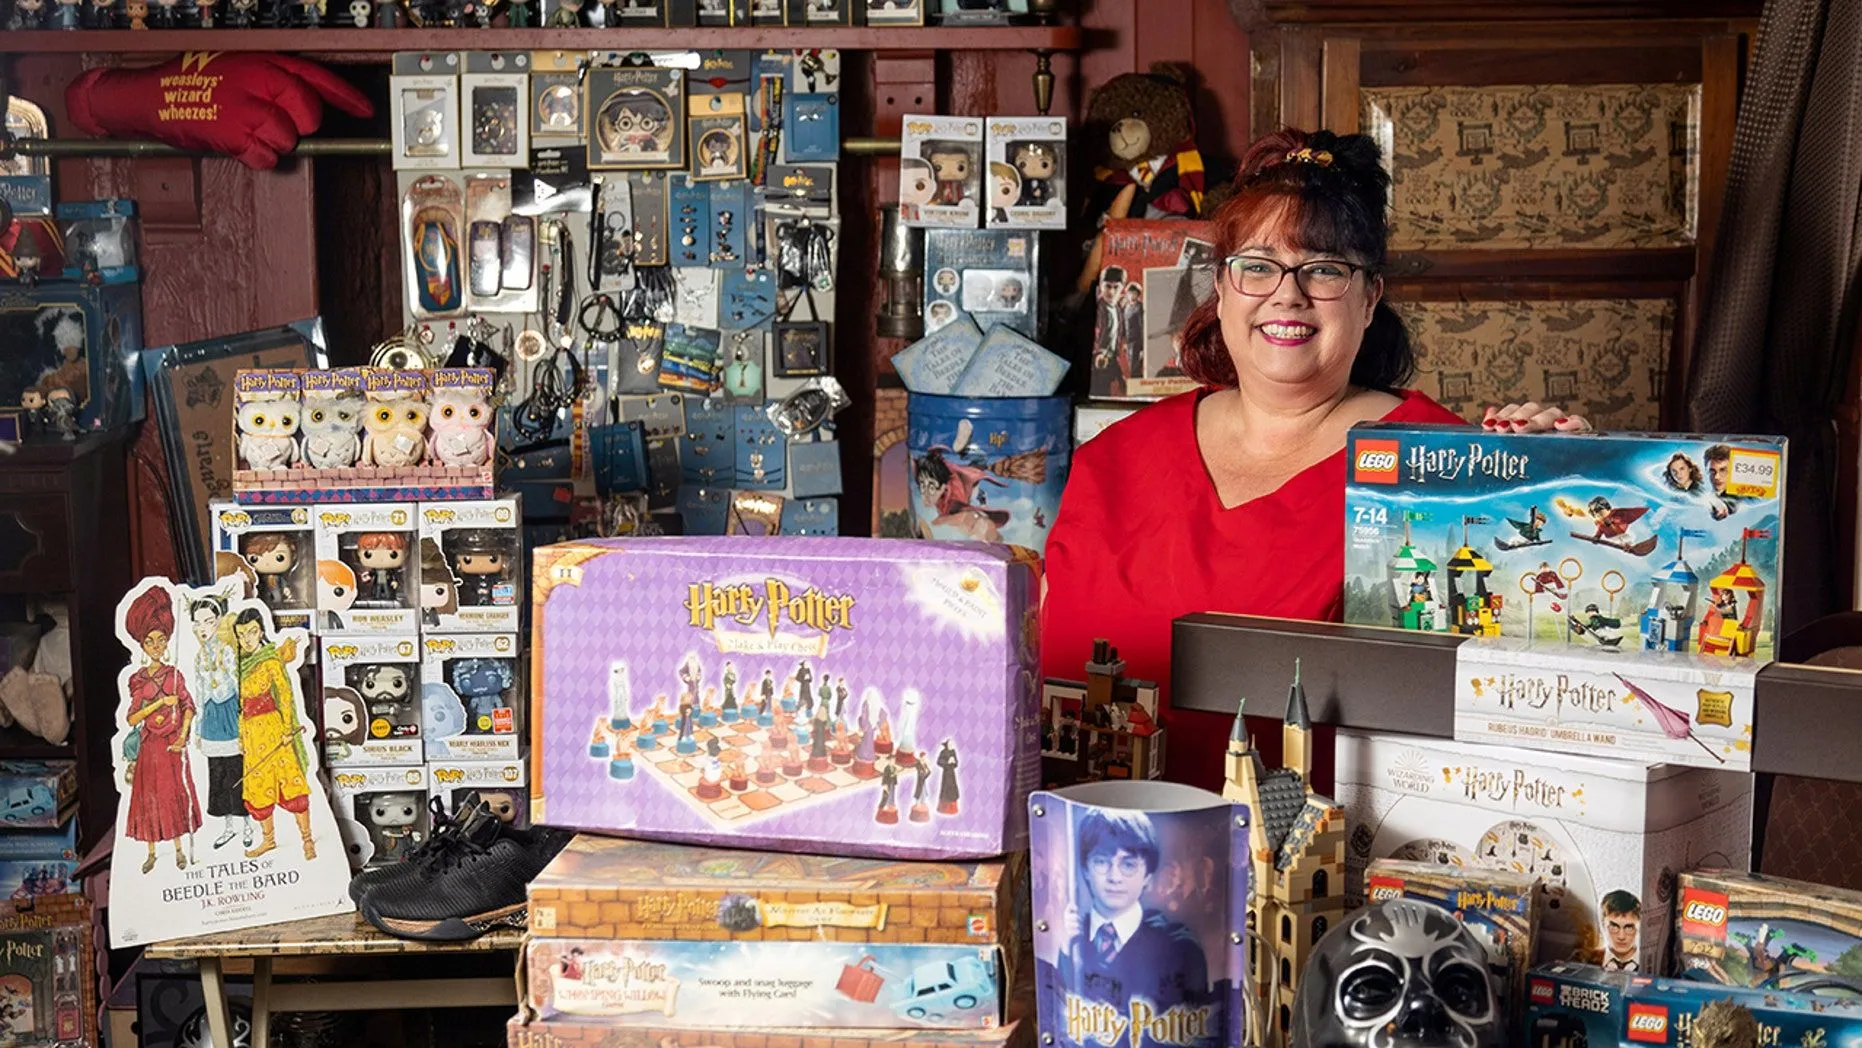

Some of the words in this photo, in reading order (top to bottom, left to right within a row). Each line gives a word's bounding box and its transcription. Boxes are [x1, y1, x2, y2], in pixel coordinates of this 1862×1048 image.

[164, 87, 212, 103] wizard
[158, 104, 217, 121] wheezes!
[241, 375, 267, 392] Harry
[267, 374, 297, 393] Potter
[306, 374, 331, 390] Harry
[331, 372, 360, 392] Potter
[367, 376, 392, 392] Harry
[392, 373, 422, 393] Potter
[434, 372, 459, 388] Harry
[460, 369, 489, 389] Potter
[1358, 453, 1396, 470] LEGO
[1405, 444, 1467, 484] Harry
[1467, 443, 1531, 484] Potter
[1735, 462, 1773, 477] £34.99
[1353, 507, 1388, 525] 7-14
[683, 580, 765, 631] Harry
[764, 577, 856, 640] Potter
[1498, 672, 1553, 712] Harry
[1556, 673, 1618, 717] Potter
[1487, 722, 1518, 736] RUBEUS
[1550, 728, 1592, 743] UMBRELLA
[1593, 732, 1617, 745] WAND
[1386, 767, 1435, 784] WIZARDING
[1392, 777, 1431, 794] WORLD
[1461, 766, 1512, 802] Harry
[1512, 769, 1567, 811] Potter
[185, 869, 205, 880] THE
[206, 859, 259, 879] TALES
[260, 860, 275, 870] OF
[161, 880, 225, 903] BEEDLE
[229, 880, 248, 892] THE
[252, 870, 301, 890] BARD
[1372, 887, 1401, 900] LEGO
[218, 890, 266, 906] ROWLING
[636, 895, 676, 919] Harry
[676, 893, 720, 919] Potter
[1457, 891, 1487, 910] Harry
[1486, 891, 1518, 912] Potter
[1686, 902, 1725, 924] LEGO
[6, 940, 44, 967] Potter
[698, 978, 732, 988] Swoop
[733, 978, 752, 987] and
[754, 980, 776, 989] snag
[777, 978, 814, 989] luggage
[1532, 984, 1554, 997] LEGO
[719, 989, 741, 998] with
[742, 988, 772, 1000] Flying
[1571, 986, 1610, 1001] BRICK
[1560, 996, 1610, 1014] HEADZ
[1066, 995, 1128, 1046] Harry
[1130, 998, 1210, 1048] Potter
[1631, 1014, 1666, 1031] LEGO
